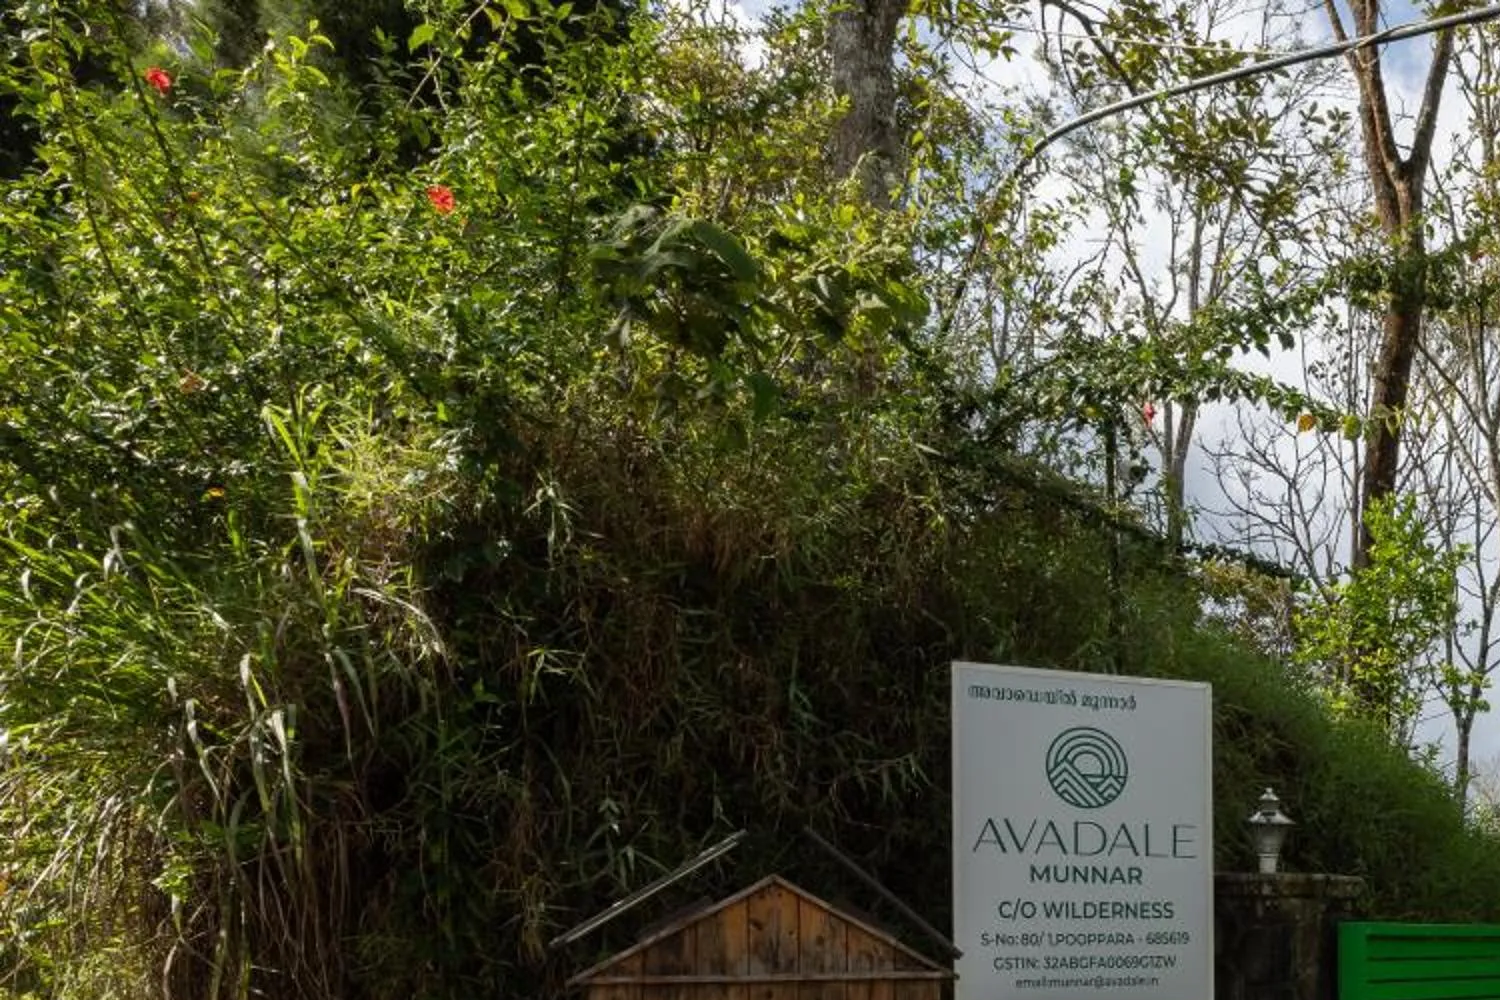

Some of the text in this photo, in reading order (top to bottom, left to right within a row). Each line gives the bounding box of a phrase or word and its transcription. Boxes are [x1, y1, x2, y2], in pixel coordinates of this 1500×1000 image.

[973, 817, 1197, 859] AVADALE
[1029, 864, 1143, 885] MUNNAR
[998, 898, 1175, 921] C/O WILDERNESS
[993, 956, 1039, 970] GSTIN:
